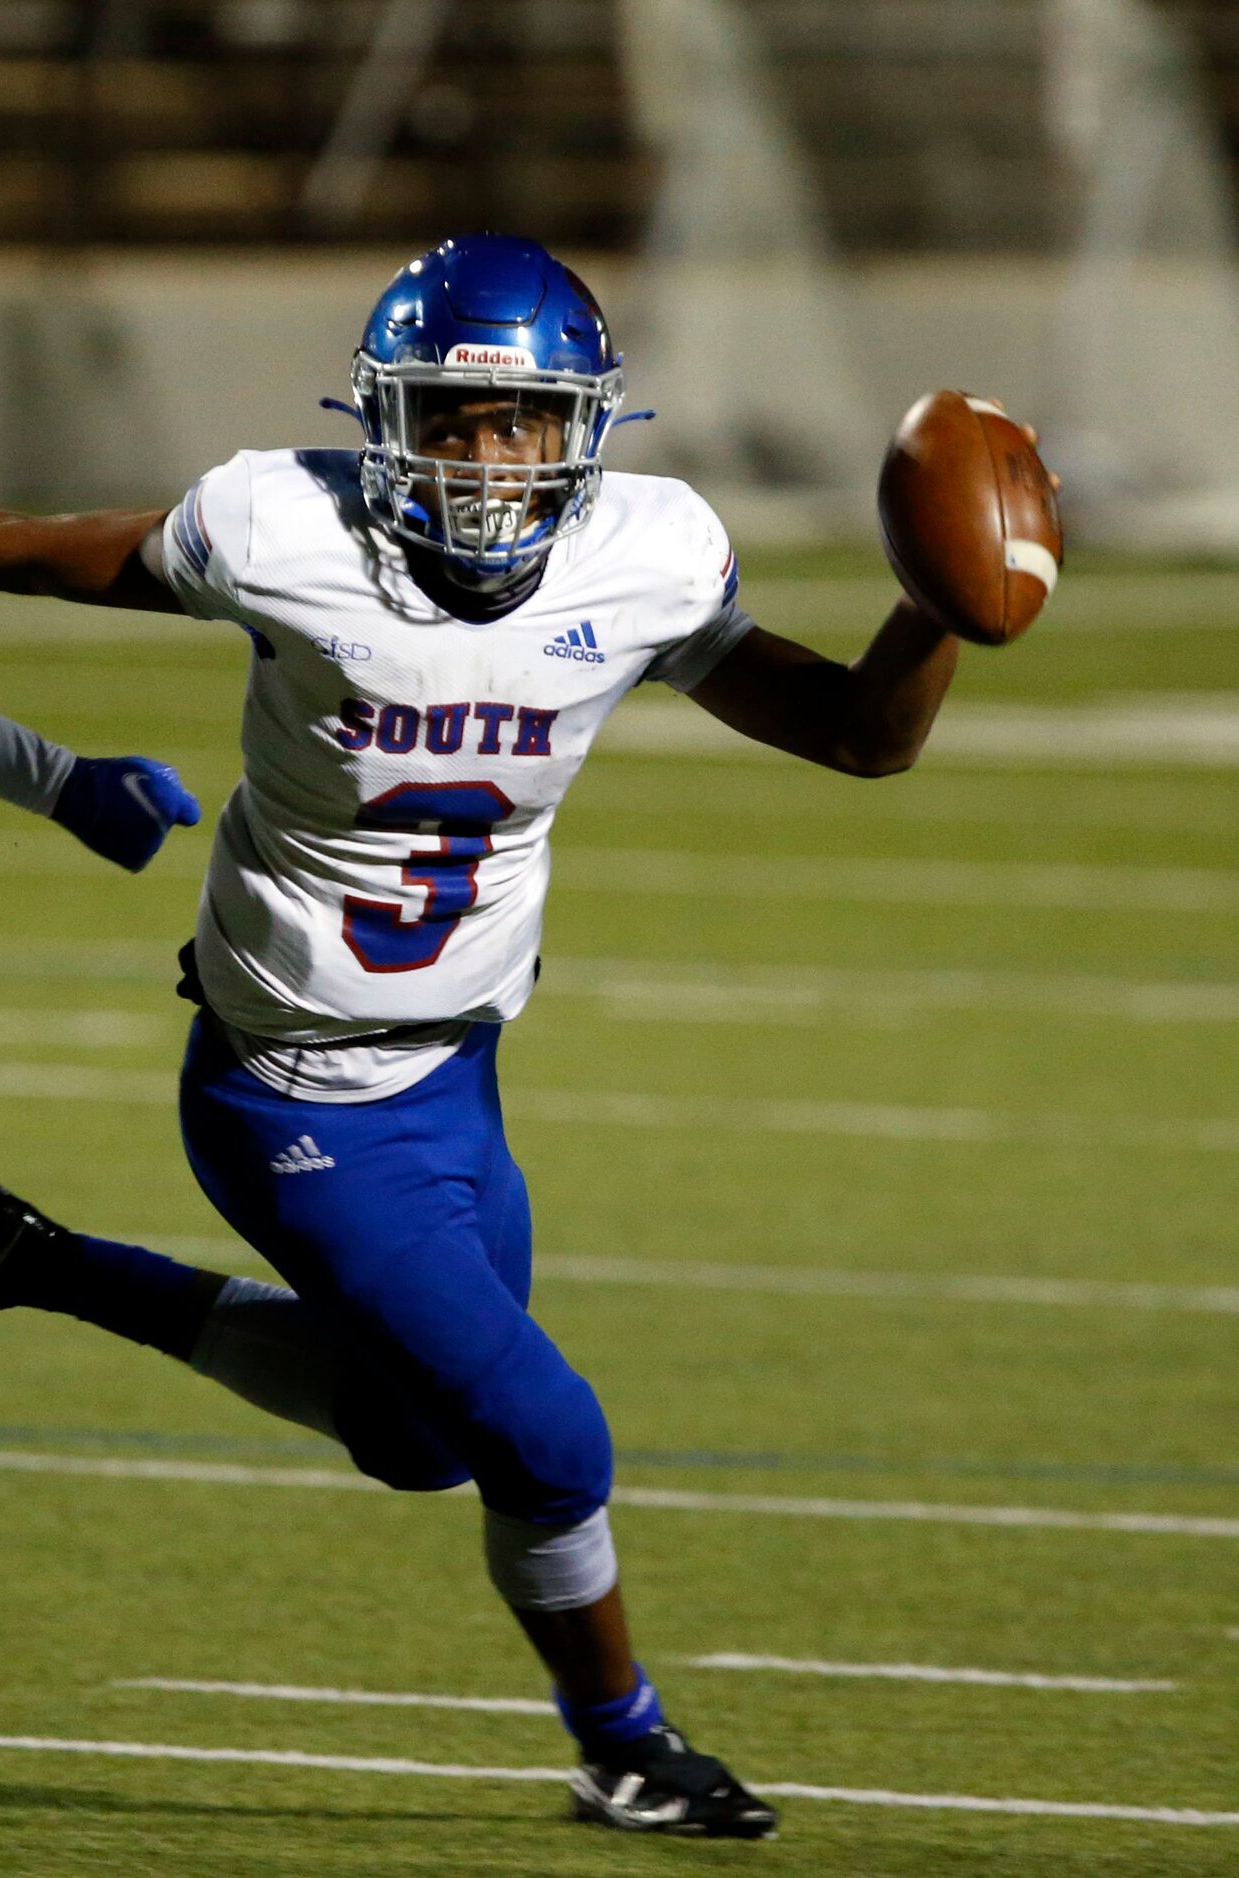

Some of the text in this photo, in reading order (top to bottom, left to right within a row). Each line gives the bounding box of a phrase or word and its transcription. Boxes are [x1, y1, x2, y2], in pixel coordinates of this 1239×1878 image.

[543, 643, 605, 664] adidas
[336, 697, 559, 756] SOUTH
[341, 780, 517, 973] 3
